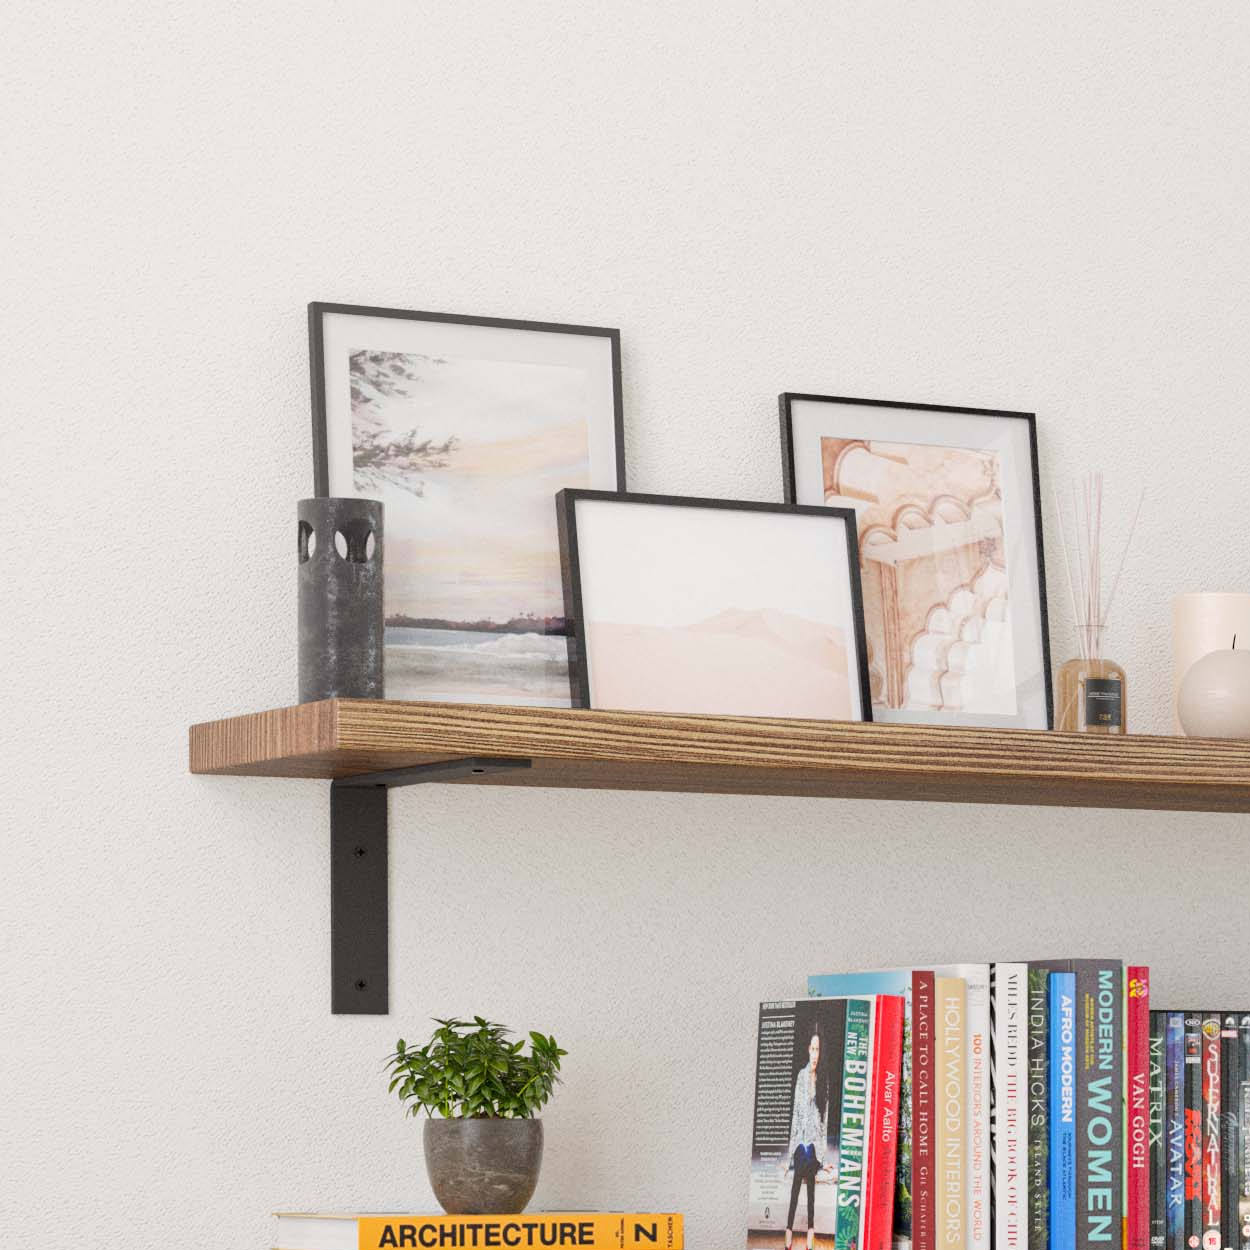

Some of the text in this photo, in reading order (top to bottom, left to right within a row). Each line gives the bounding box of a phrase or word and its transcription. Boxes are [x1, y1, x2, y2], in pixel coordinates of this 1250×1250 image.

[919, 980, 928, 990] A
[1008, 974, 1018, 1021] MILES
[919, 995, 929, 1040] PLACE
[846, 1032, 858, 1055] NEW
[859, 1037, 869, 1057] THE
[919, 1045, 929, 1065] TO
[1008, 1025, 1018, 1066] REDD
[1061, 995, 1073, 1122] AFRO MODERN
[883, 1071, 896, 1103] Alvar
[919, 1070, 929, 1109] CALL
[1008, 1073, 1018, 1104] THE
[1087, 970, 1113, 1242] MODERN WOMEN
[1150, 1036, 1163, 1148] MATRIX
[881, 1107, 894, 1142] Aalto
[919, 1112, 929, 1156] HOME
[944, 997, 960, 1242] HOLLYWOOD INTERIORS
[1008, 1108, 1018, 1134] BIG
[1031, 991, 1045, 1233] INDIA HICKS ISLAND STYLE
[1133, 1073, 1145, 1169] VAN GOGH
[838, 1061, 867, 1209] BOHEMIANS
[972, 1034, 982, 1241] 100 INTERIORS AROUND THE WORLD
[1207, 1043, 1220, 1226] SUPERNATURAL
[1008, 1138, 1018, 1183] BOOK
[1169, 1120, 1183, 1209] AVATAR
[1008, 1187, 1018, 1207] OF
[379, 1222, 594, 1248] ARCHITECTURE
[634, 1223, 657, 1242] Z
